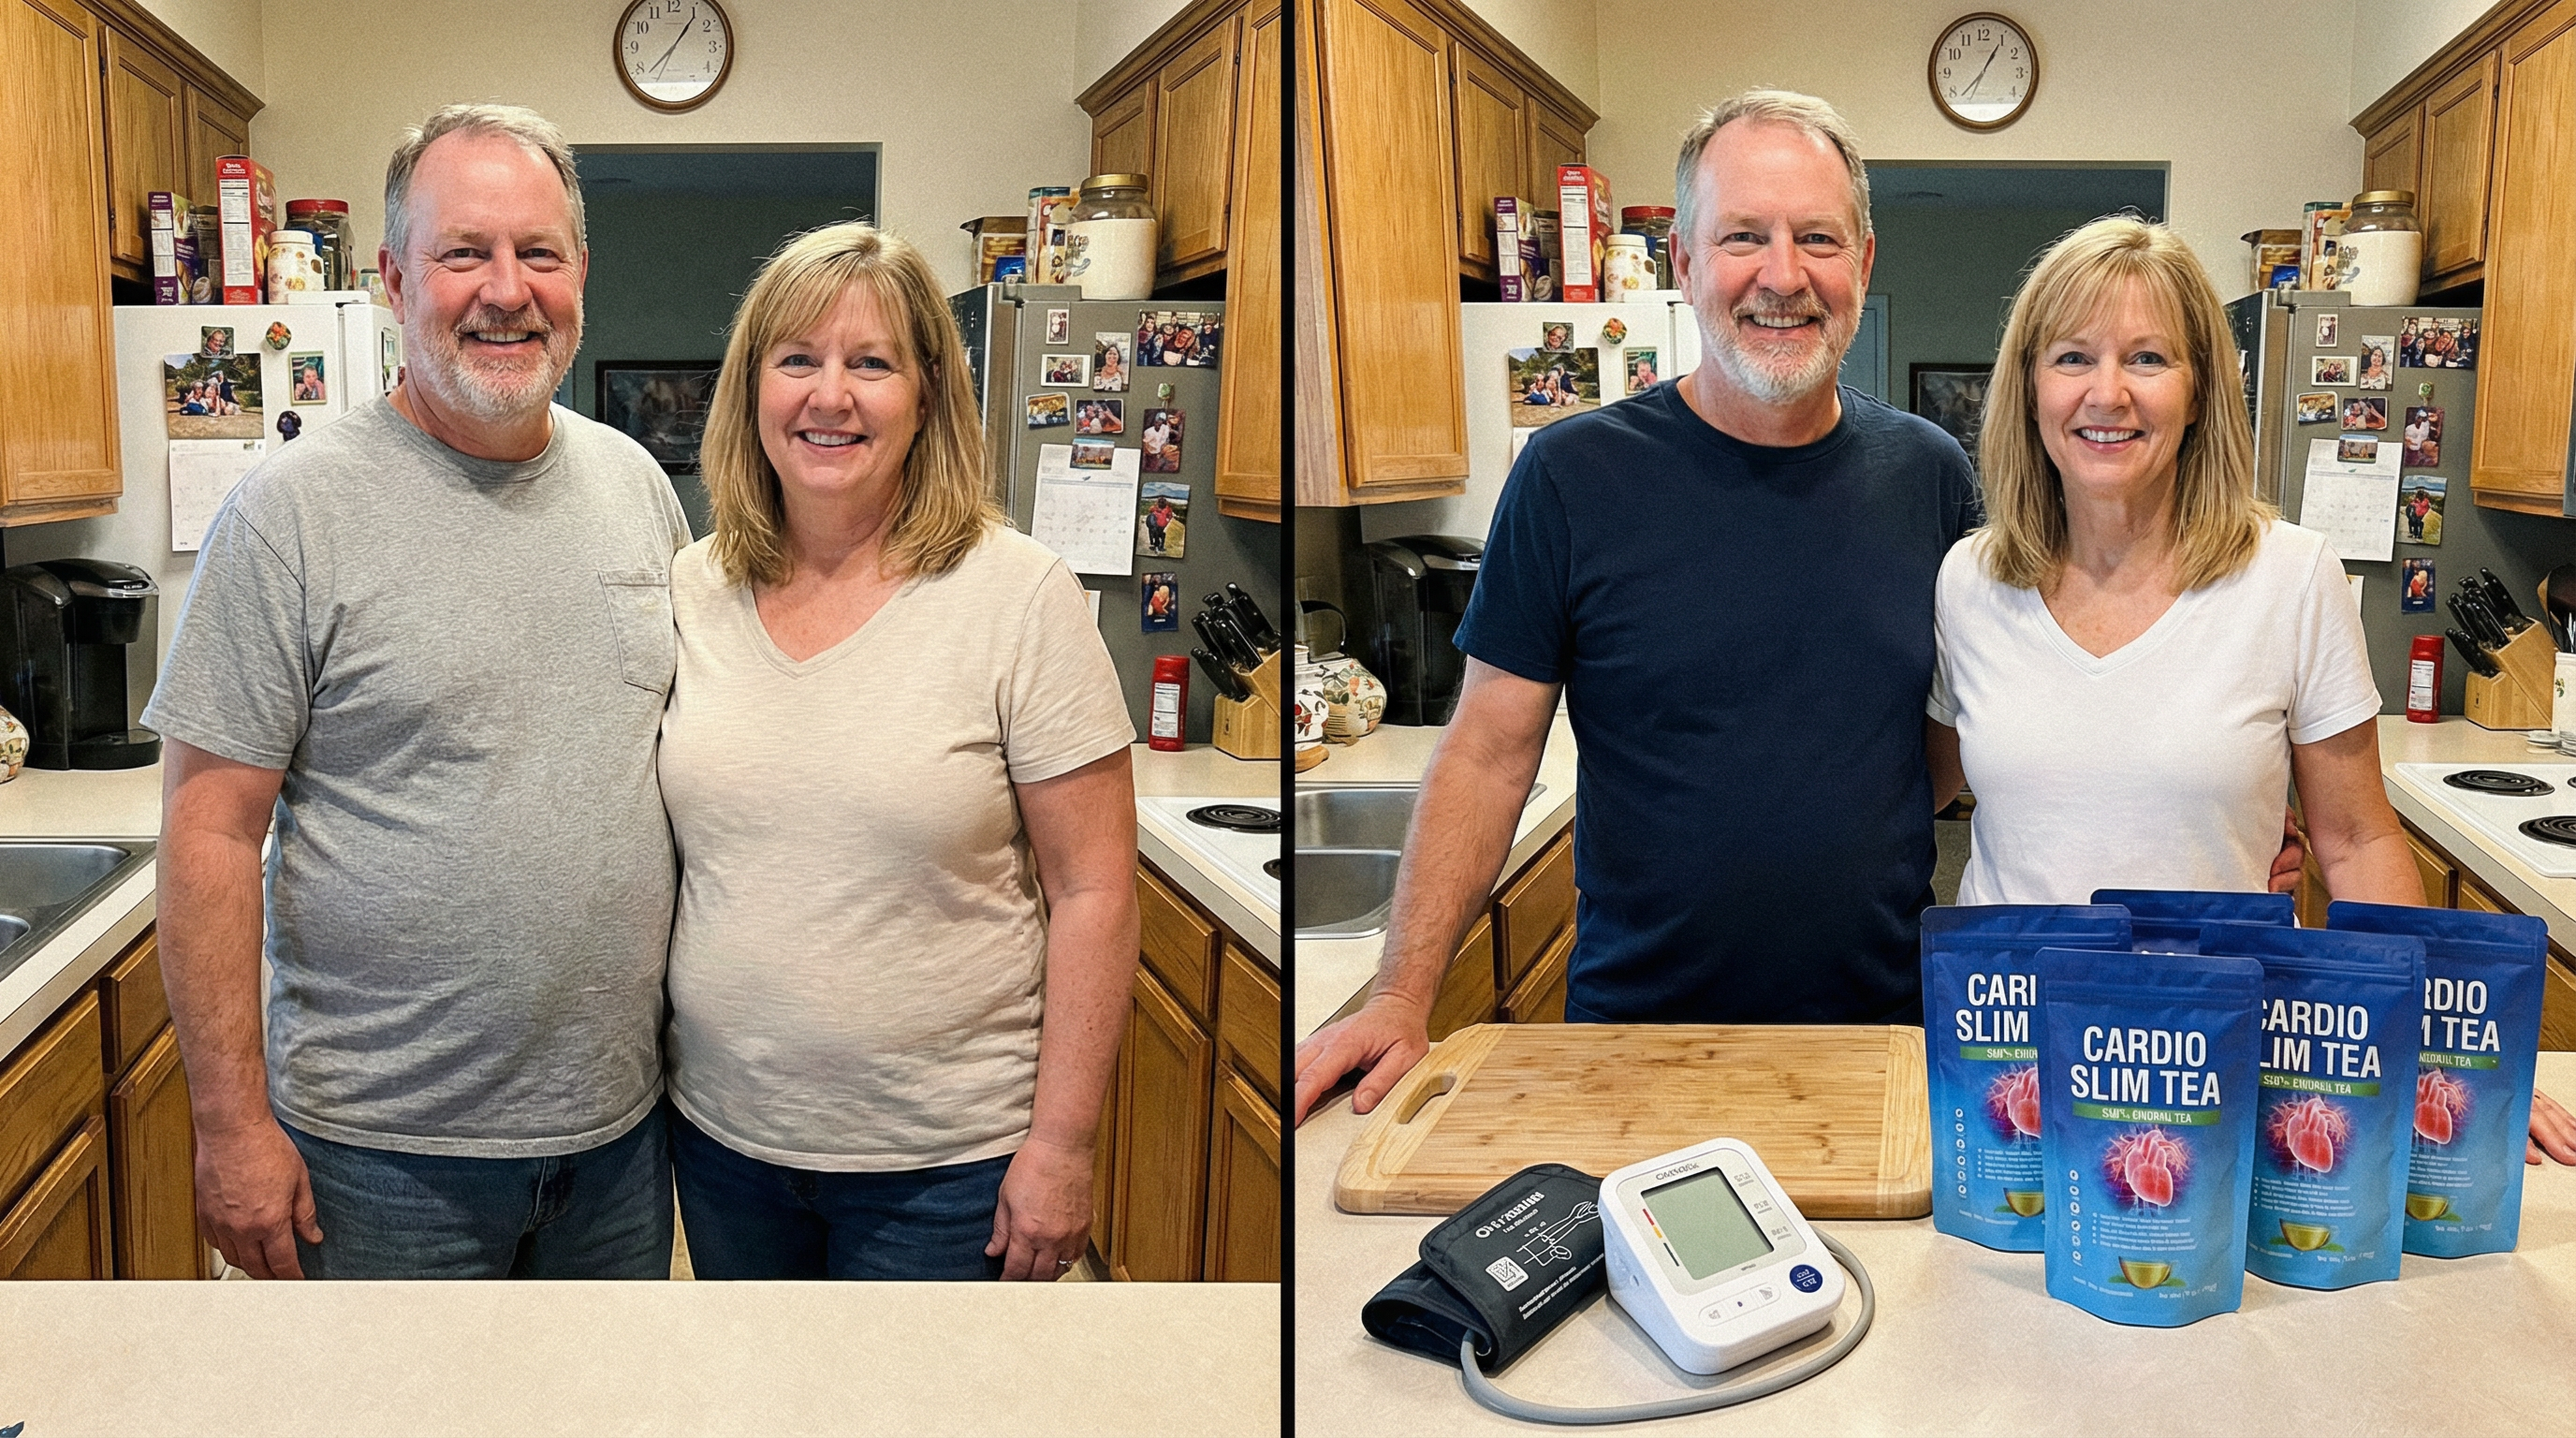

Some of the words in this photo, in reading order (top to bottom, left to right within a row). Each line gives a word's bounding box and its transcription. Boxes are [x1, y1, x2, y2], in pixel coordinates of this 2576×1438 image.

[650, 7, 661, 19] 11
[637, 21, 649, 34] 10
[702, 19, 710, 32] 2
[1961, 34, 1970, 46] 11
[1977, 28, 1990, 41] 12
[2000, 34, 2004, 46] 1
[630, 40, 638, 53] 9
[709, 40, 717, 53] 3
[2010, 47, 2018, 59] 2
[1949, 48, 1961, 60] 10
[1942, 66, 1951, 79] 9
[2015, 66, 2024, 79] 3
[1949, 85, 1957, 98] 8
[1955, 1008, 2028, 1043] SLIM
[2440, 1016, 2500, 1052] TEA
[2083, 1025, 2207, 1067] CARDIO
[2320, 1041, 2381, 1078] TEA
[2454, 1055, 2471, 1066] TEA
[2071, 1064, 2149, 1103] SLIM
[2159, 1070, 2221, 1107] TEA
[2334, 1083, 2351, 1094] TEA
[2174, 1112, 2191, 1123] TEA
